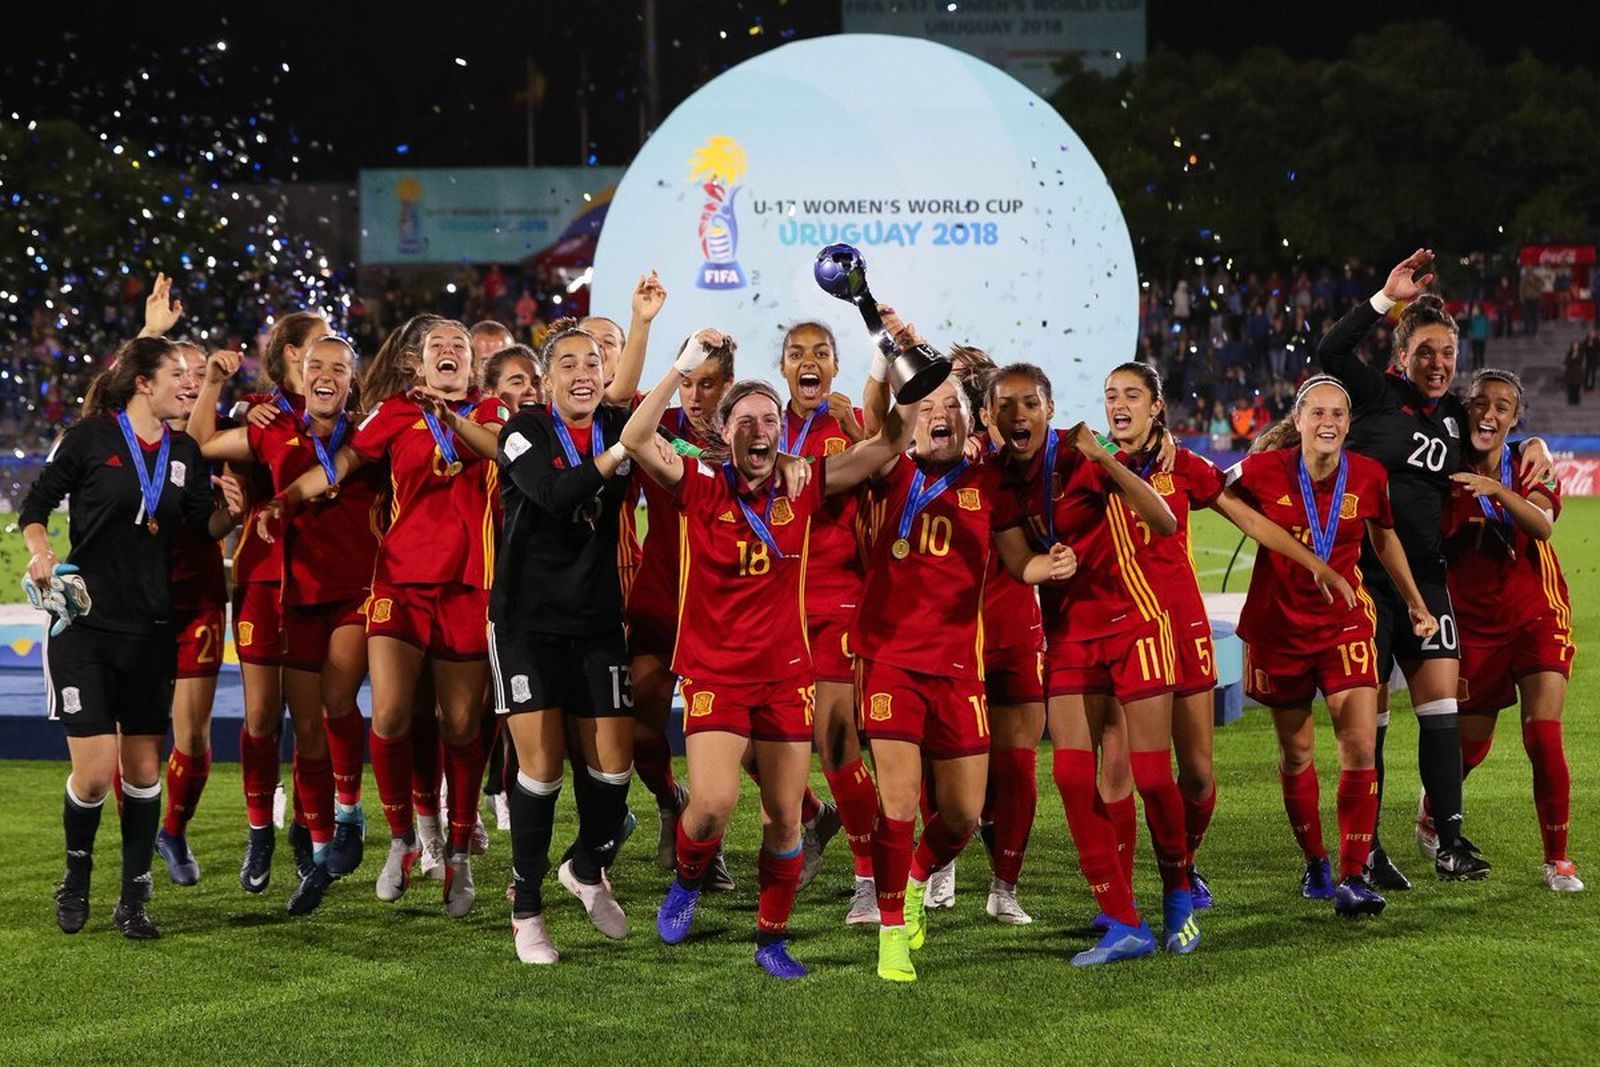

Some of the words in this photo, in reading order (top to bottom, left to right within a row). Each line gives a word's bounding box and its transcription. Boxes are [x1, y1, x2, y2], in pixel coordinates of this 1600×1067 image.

[753, 199, 796, 215] U-17
[803, 199, 901, 215] WOMEN'S
[907, 199, 980, 215] WORLD
[985, 199, 1024, 214] CUP
[778, 219, 922, 248] URUGUAY
[932, 222, 999, 246] 2018
[704, 269, 740, 284] FIFA
[1407, 431, 1448, 473] 20
[919, 512, 952, 557] 10
[1468, 516, 1486, 551] 7
[736, 540, 771, 577] 18
[1420, 613, 1457, 651] 20
[1135, 636, 1161, 682] 11
[1194, 637, 1211, 676] 5
[1337, 640, 1369, 677] 19
